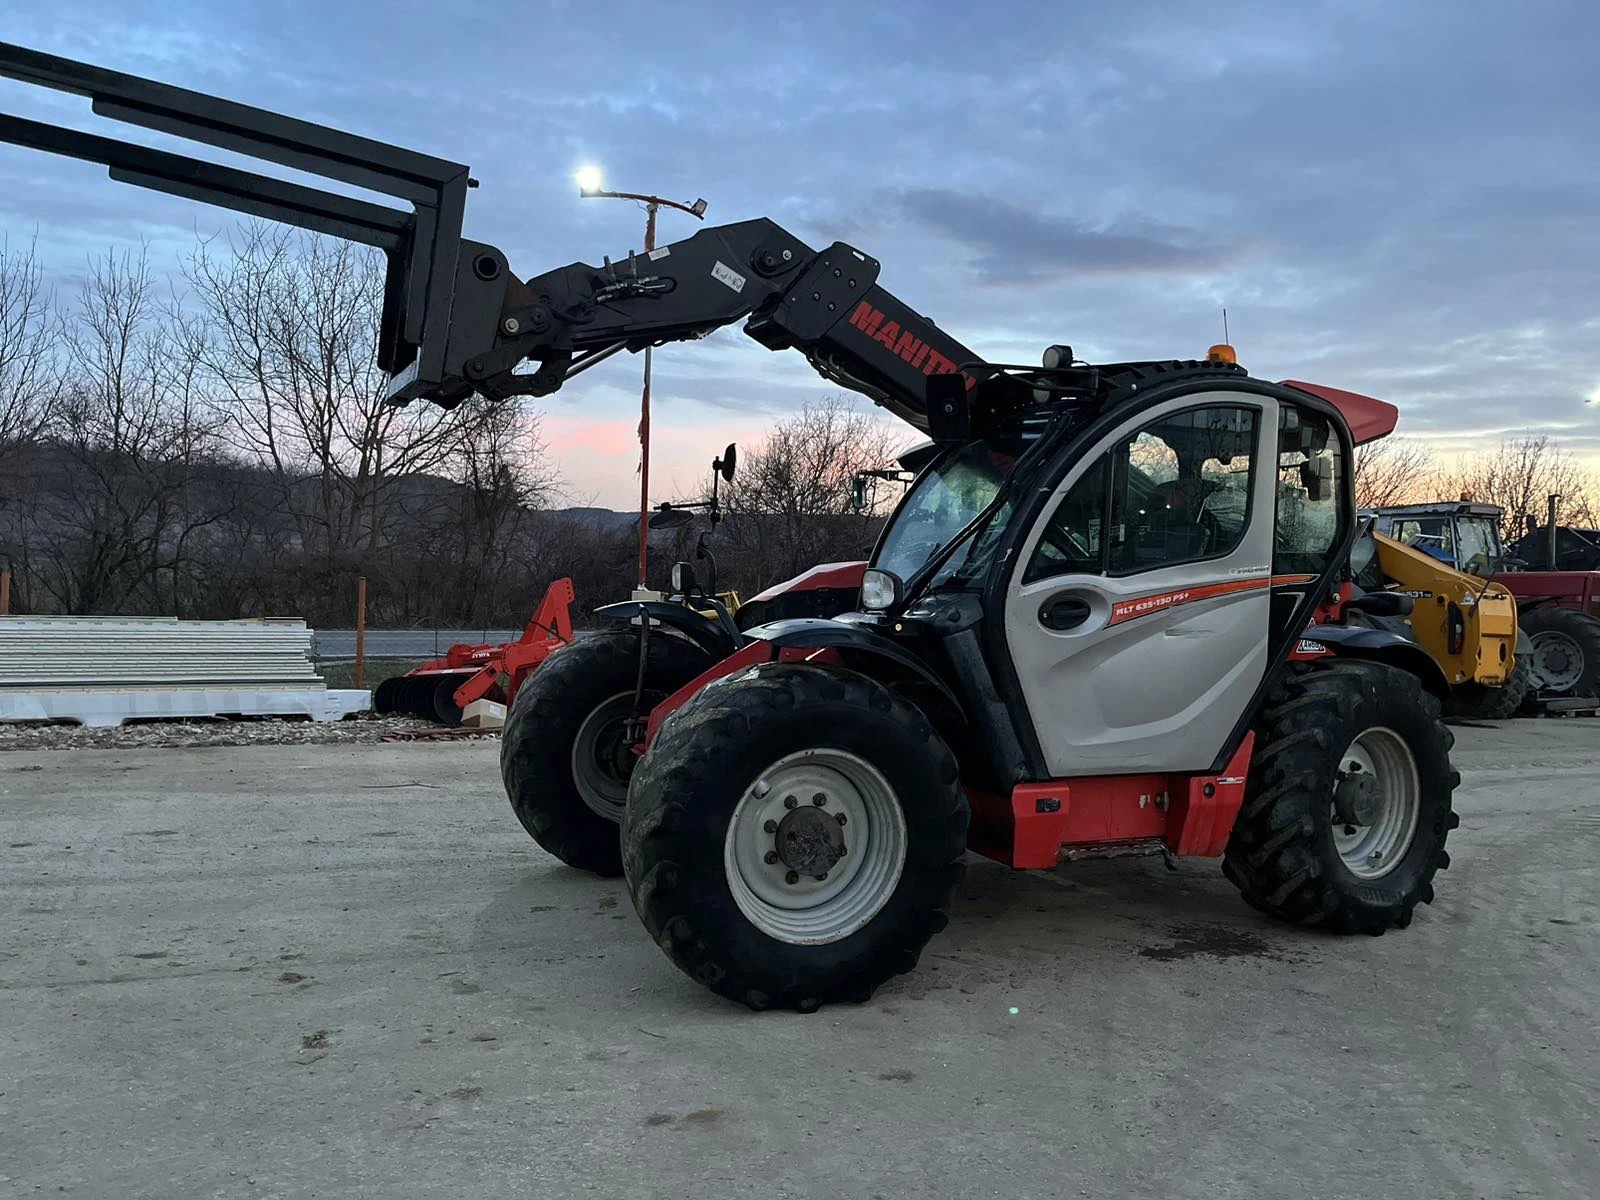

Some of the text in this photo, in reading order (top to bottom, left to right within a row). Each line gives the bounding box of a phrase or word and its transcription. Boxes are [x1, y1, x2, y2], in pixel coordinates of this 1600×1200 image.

[849, 300, 976, 392] MANIT
[1116, 592, 1190, 616] MLT 635-130 PS+
